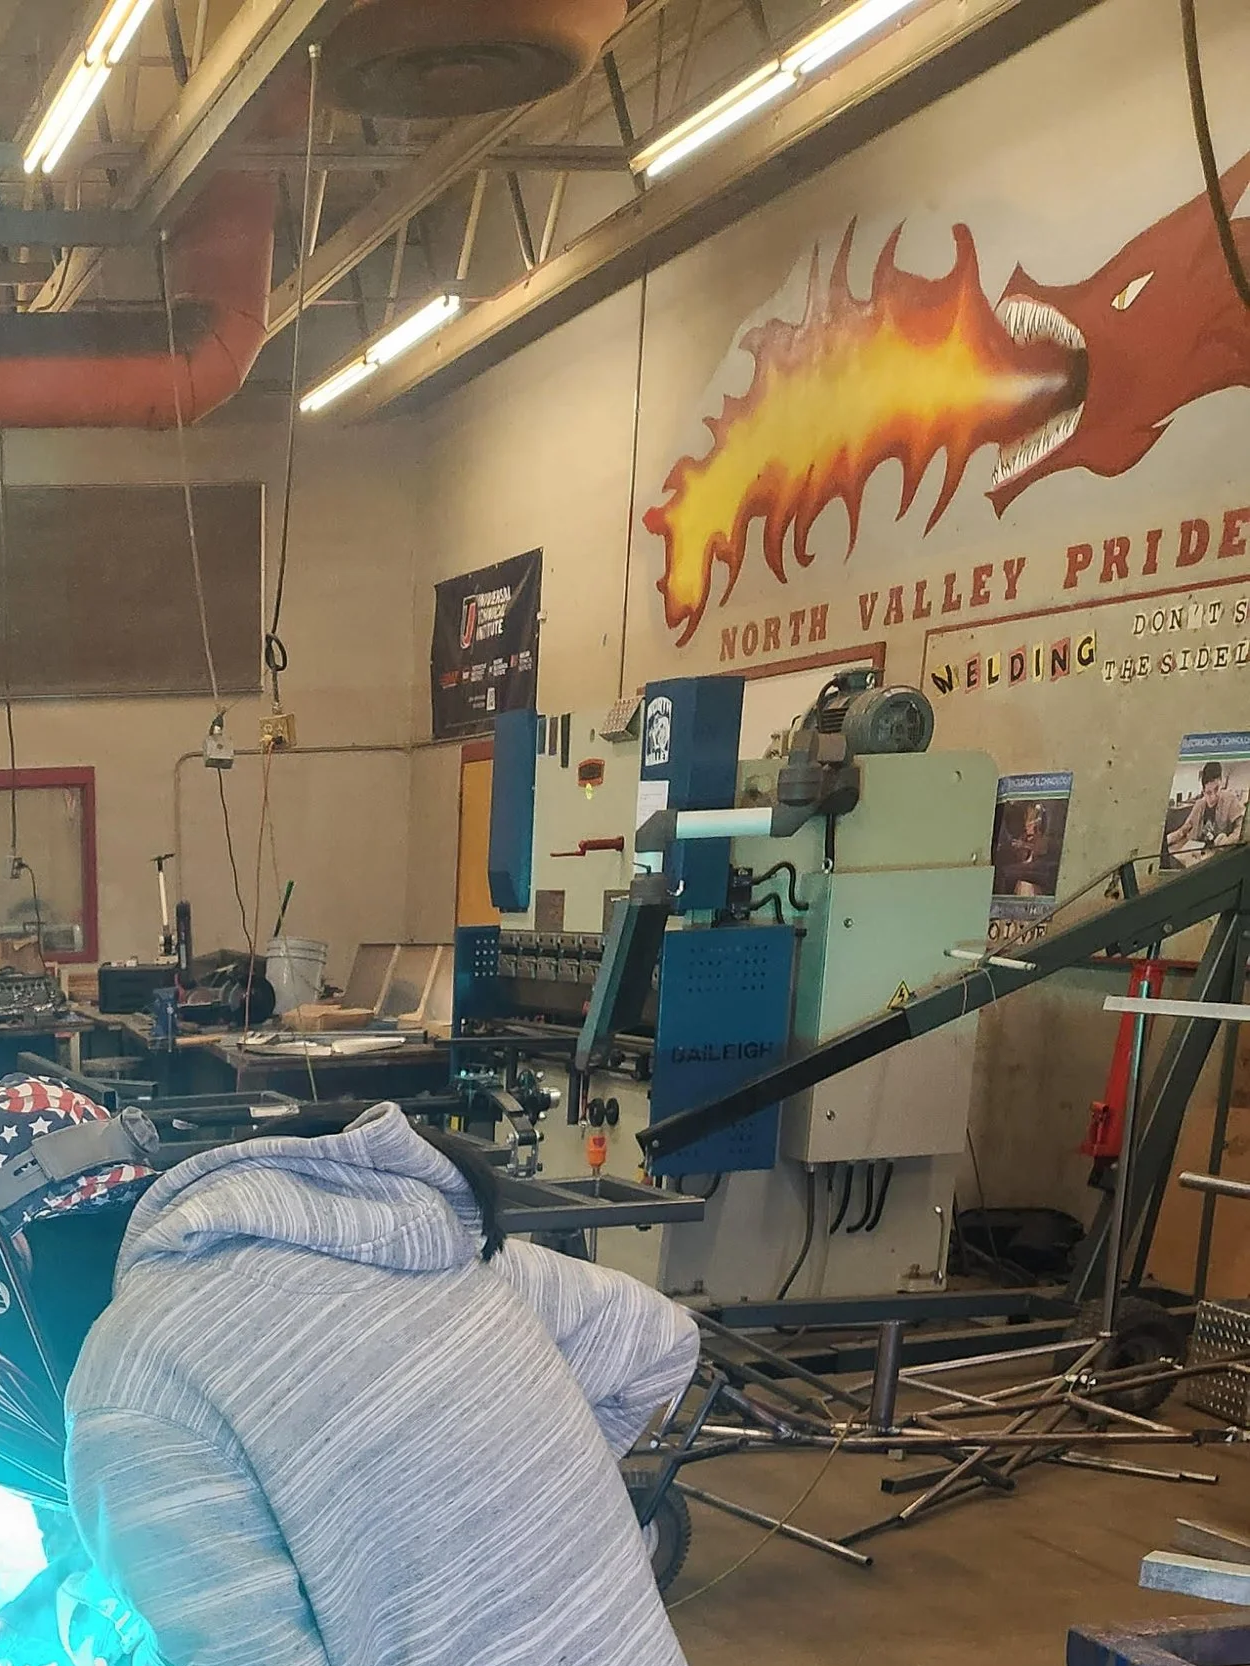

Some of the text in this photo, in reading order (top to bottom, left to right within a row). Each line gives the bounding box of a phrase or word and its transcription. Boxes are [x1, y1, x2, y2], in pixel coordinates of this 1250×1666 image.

[719, 506, 1250, 662] NORTH VALLEY PRIDE
[1133, 602, 1221, 635] DON'T
[931, 634, 1095, 696] WELDING
[1105, 655, 1150, 682] THE
[671, 1041, 774, 1063] BAILEIGH
